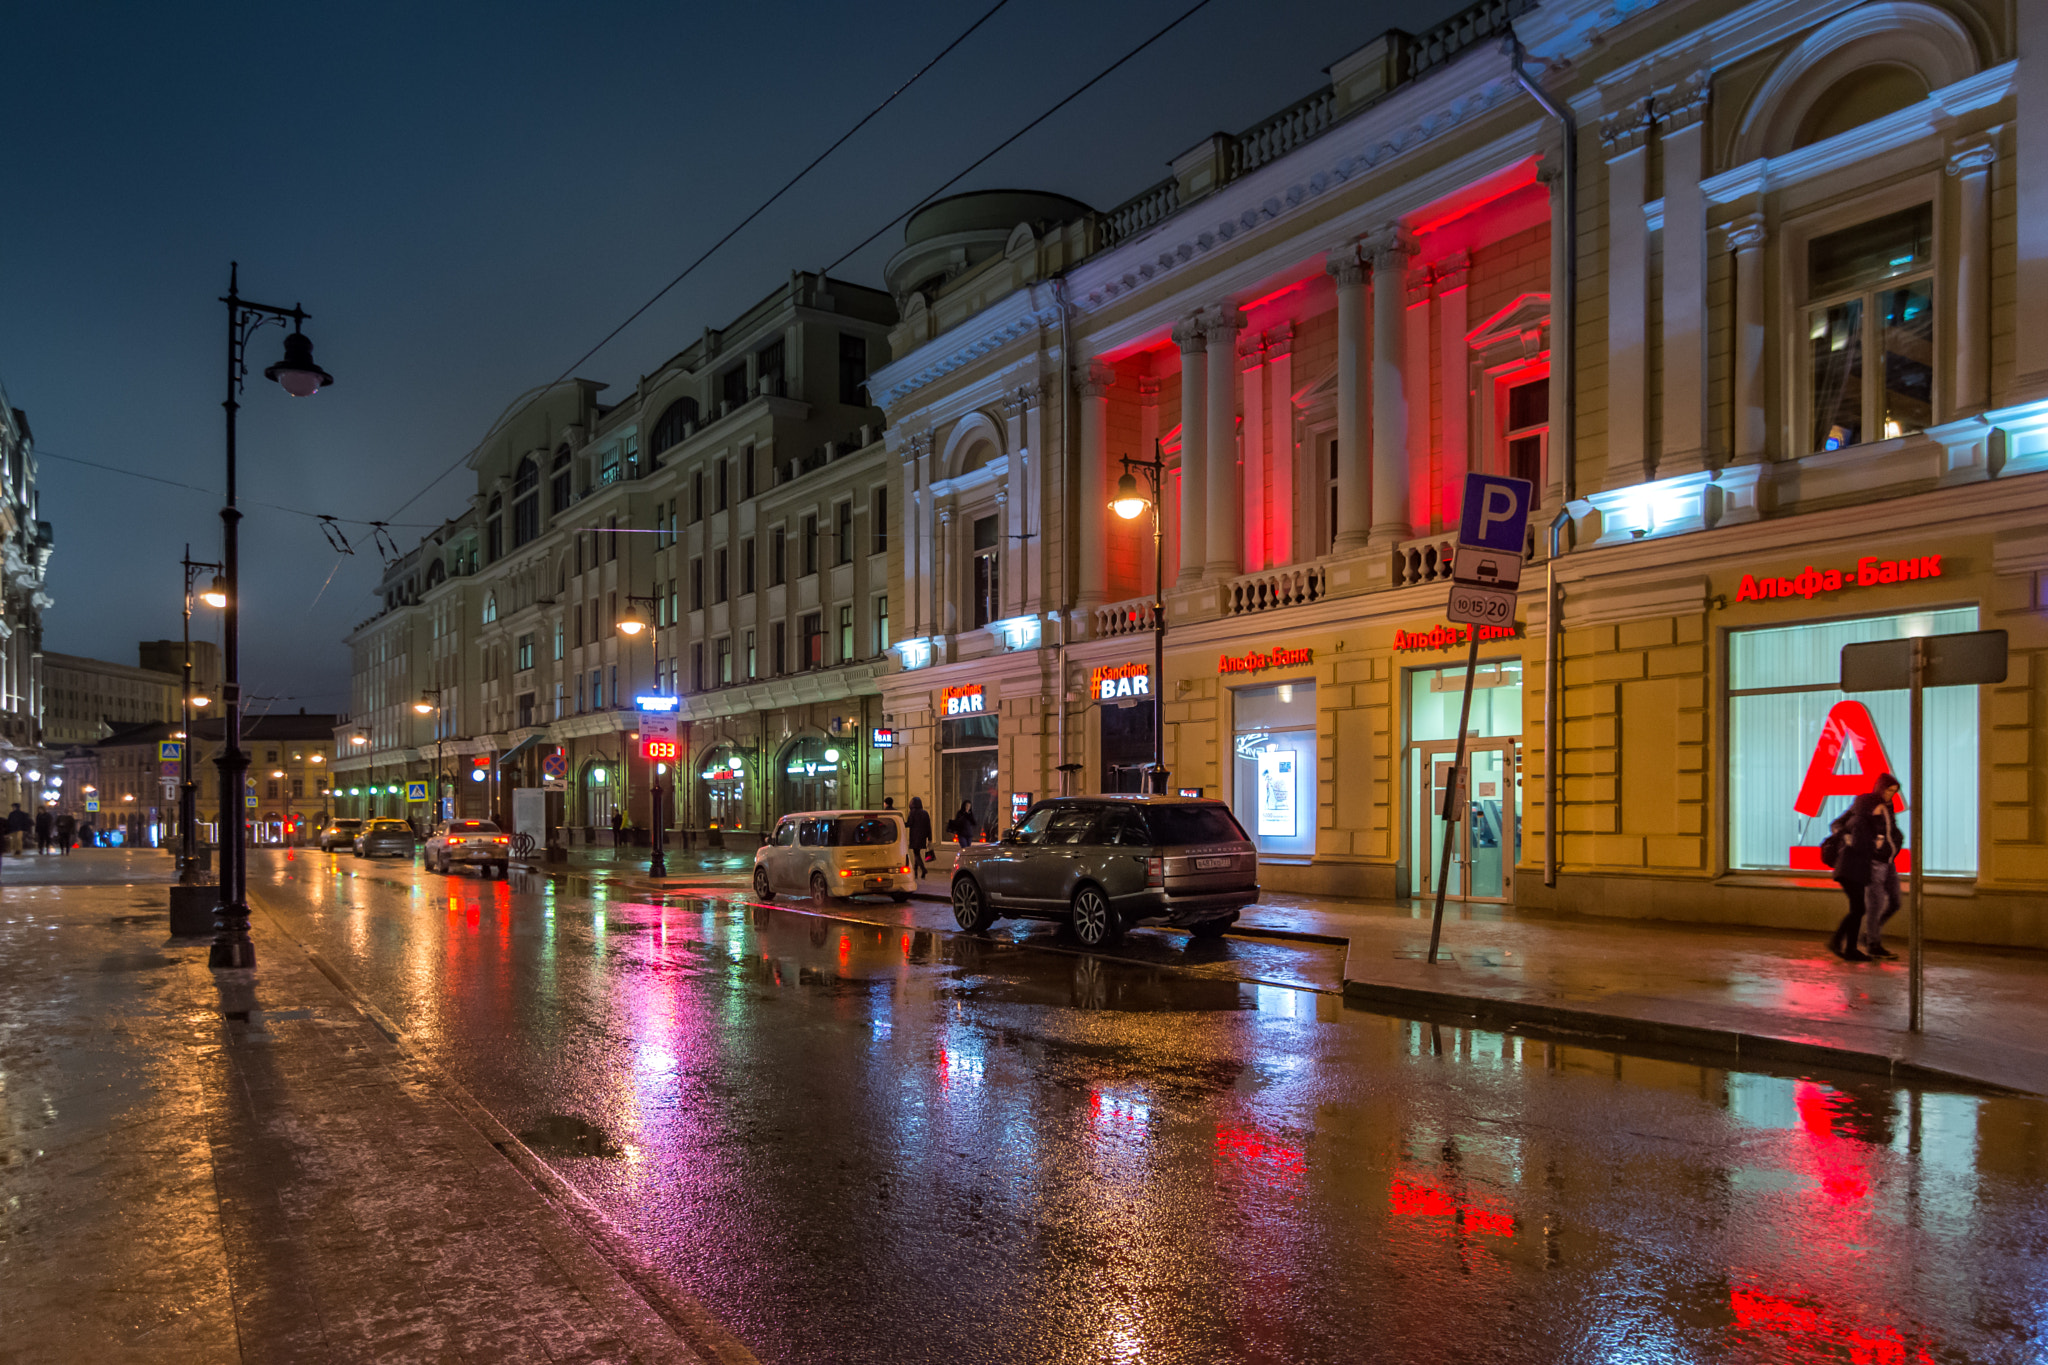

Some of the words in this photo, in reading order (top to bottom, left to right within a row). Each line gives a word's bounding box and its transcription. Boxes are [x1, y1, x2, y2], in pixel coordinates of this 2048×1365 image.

[1478, 483, 1518, 540] P
[1458, 599, 1468, 610] 10
[1471, 600, 1483, 613] 15
[1487, 601, 1507, 617] 20
[1101, 675, 1149, 699] BAR
[947, 694, 983, 715] BAR
[649, 742, 675, 757] 033
